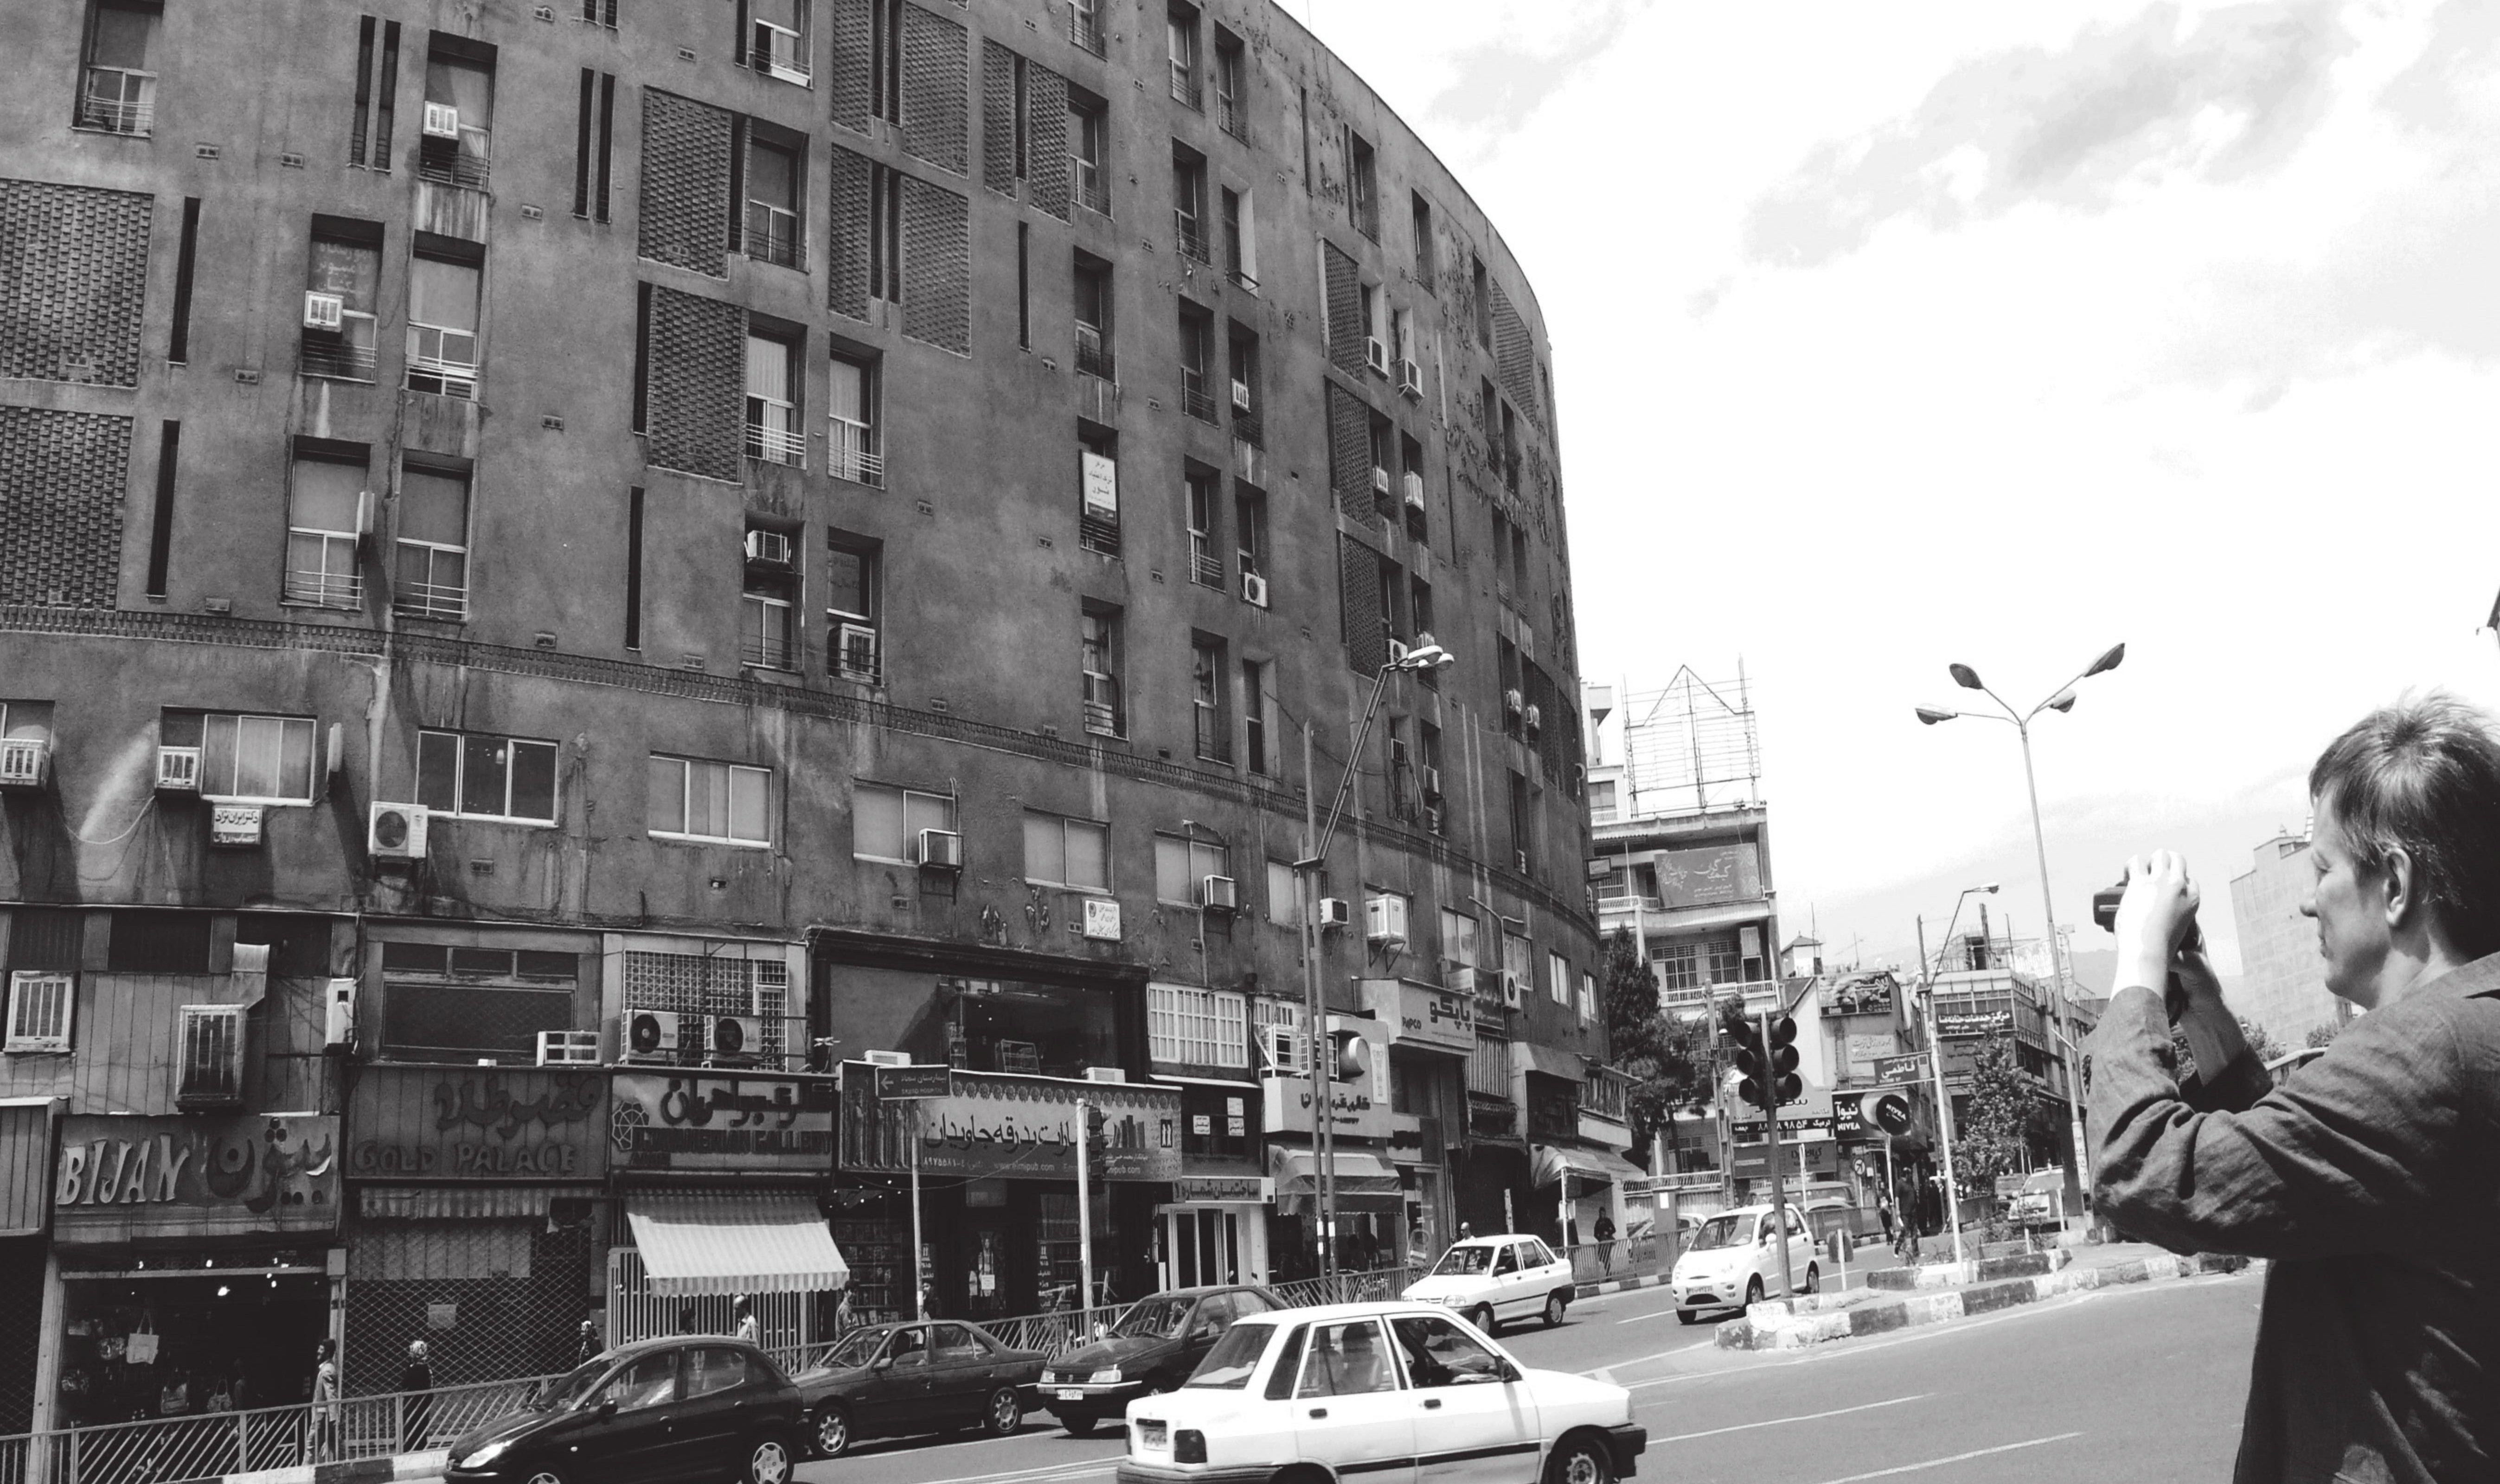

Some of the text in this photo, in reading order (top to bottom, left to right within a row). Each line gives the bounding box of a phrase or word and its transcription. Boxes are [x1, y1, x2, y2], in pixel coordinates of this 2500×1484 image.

[1430, 996, 1472, 1031] پاپکو
[917, 1073, 947, 1084] بیمارستان
[1882, 1060, 1916, 1078] فاطمی
[434, 1071, 603, 1139] قصر طلا
[1834, 1101, 1858, 1121] نیوآ
[1886, 1103, 1906, 1121] NIVEA
[924, 1112, 995, 1151] جاویدان
[994, 1115, 1037, 1153] بدرقه
[1758, 1119, 1808, 1131] ۸۸۸۹۸۵۴
[1837, 1122, 1861, 1131] NIVEA
[354, 1140, 578, 1173] GOLD PALACE
[752, 1130, 833, 1155] GALLERY
[56, 1134, 190, 1205] BIJAN
[206, 1116, 333, 1213] بیژن
